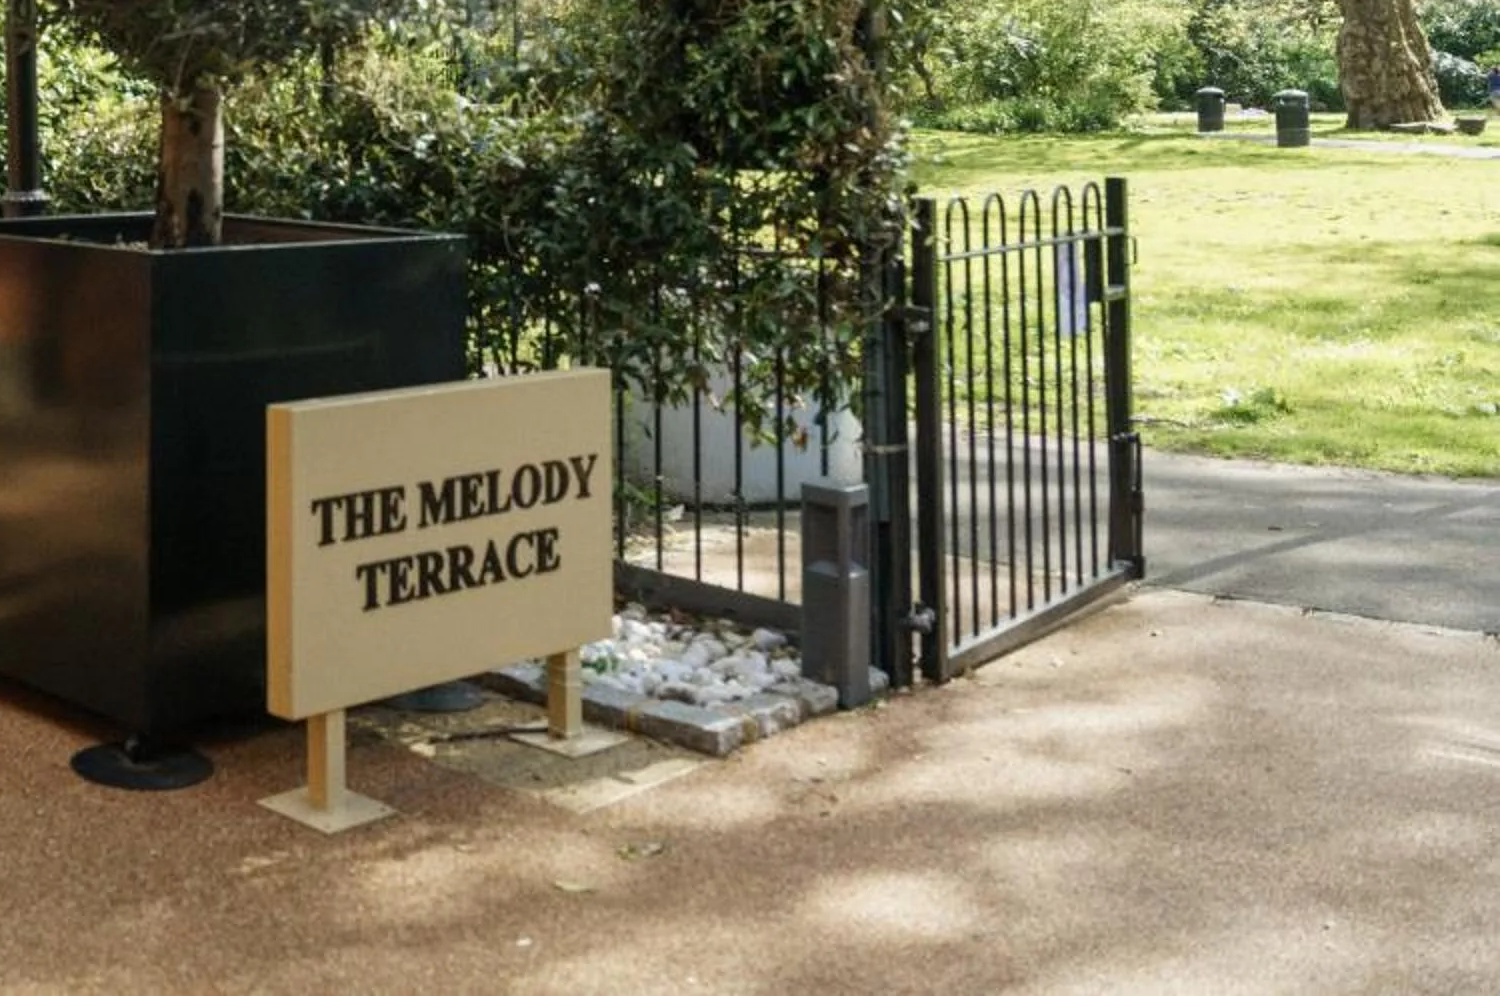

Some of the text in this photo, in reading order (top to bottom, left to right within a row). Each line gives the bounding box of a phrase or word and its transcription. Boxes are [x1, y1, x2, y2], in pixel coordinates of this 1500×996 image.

[311, 453, 598, 548] THE MELODY
[355, 527, 562, 613] TERRACE
